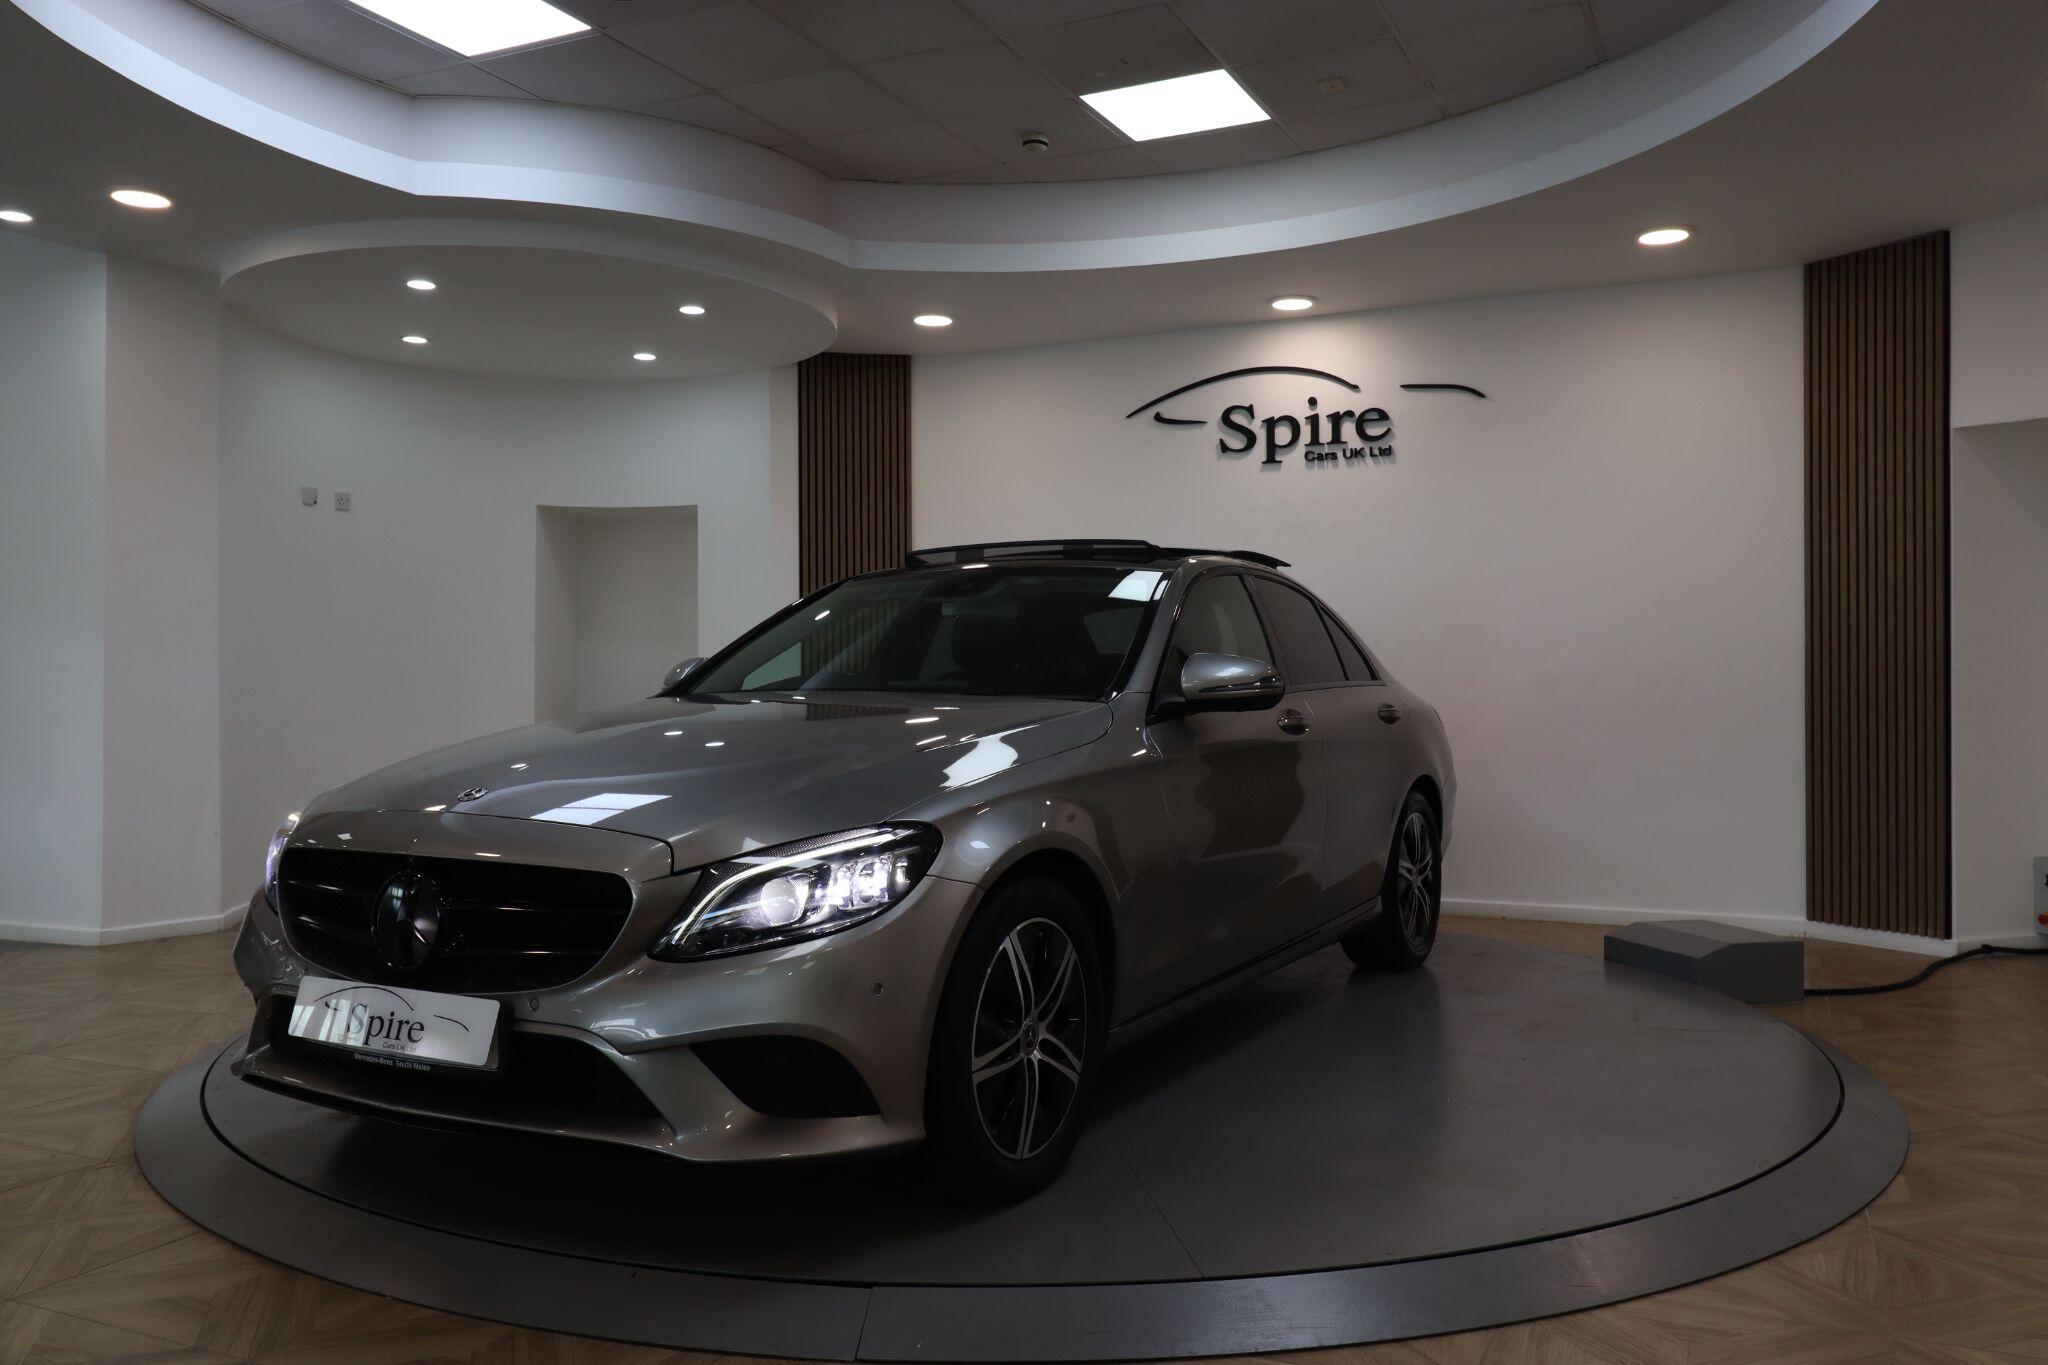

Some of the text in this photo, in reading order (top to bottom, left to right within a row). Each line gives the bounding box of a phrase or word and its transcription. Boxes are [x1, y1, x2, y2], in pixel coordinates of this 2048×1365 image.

[1219, 396, 1391, 465] Spire
[1304, 444, 1392, 463] Cars UK Ltd
[347, 1003, 425, 1046] Spire
[383, 1041, 395, 1049] Cars
